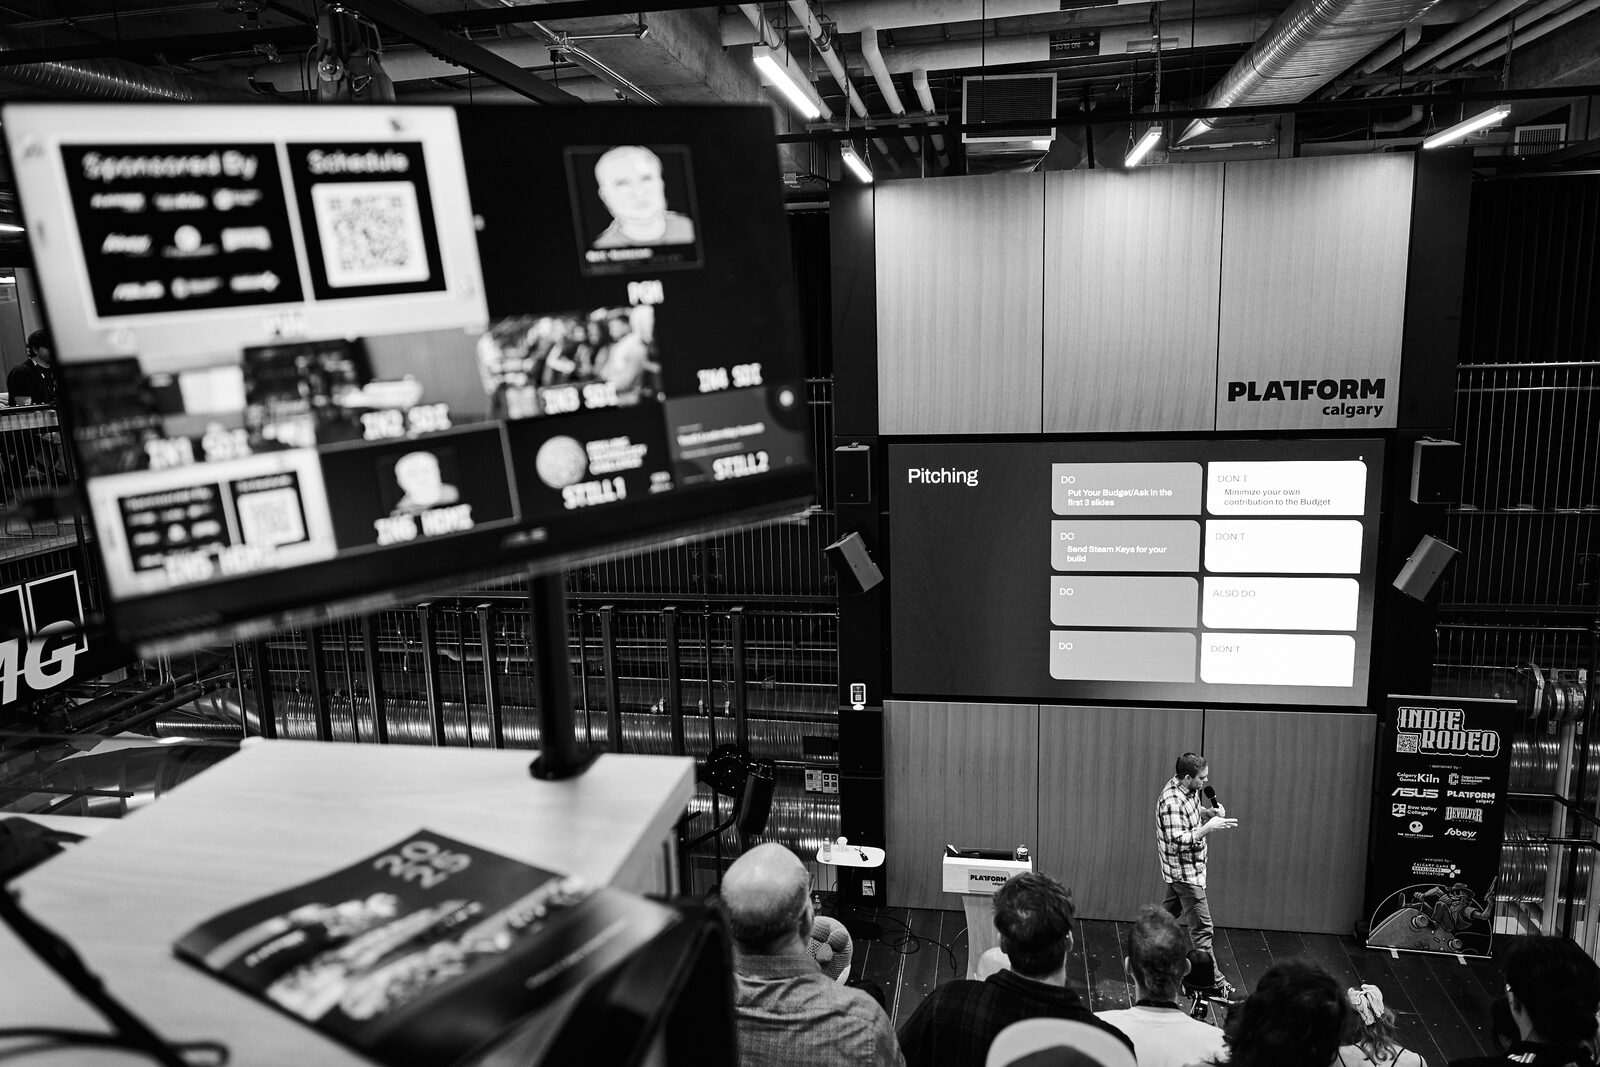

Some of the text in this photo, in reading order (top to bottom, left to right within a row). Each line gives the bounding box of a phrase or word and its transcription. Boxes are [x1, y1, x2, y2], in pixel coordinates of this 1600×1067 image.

[82, 149, 259, 183] Sponsored By
[307, 148, 410, 175] Schedule
[1228, 378, 1386, 402] PLATFORM
[1322, 402, 1384, 418] calgary
[908, 467, 979, 487] Pitching
[1060, 476, 1076, 484] DO
[1068, 489, 1081, 497] Put
[1102, 488, 1150, 498] Budget/Ask
[1159, 488, 1173, 496] the
[1090, 498, 1115, 506] slides
[1300, 498, 1331, 507] Budget
[1060, 532, 1075, 540] DO
[1215, 532, 1246, 540] DON'T
[1115, 546, 1135, 555] Keys
[1148, 546, 1168, 555] your
[1066, 555, 1086, 563] build
[1059, 588, 1074, 596] DO
[1212, 590, 1256, 598] ALSO DO
[1058, 642, 1074, 650] DO
[1400, 708, 1461, 730] INDIE
[1421, 729, 1496, 752] RODEO
[1418, 773, 1440, 783] Kiln
[1391, 787, 1439, 799] ASUS
[1447, 790, 1496, 799] PLATFORM
[1444, 806, 1483, 822] DEVOLVER
[1444, 828, 1477, 838] Sobeys
